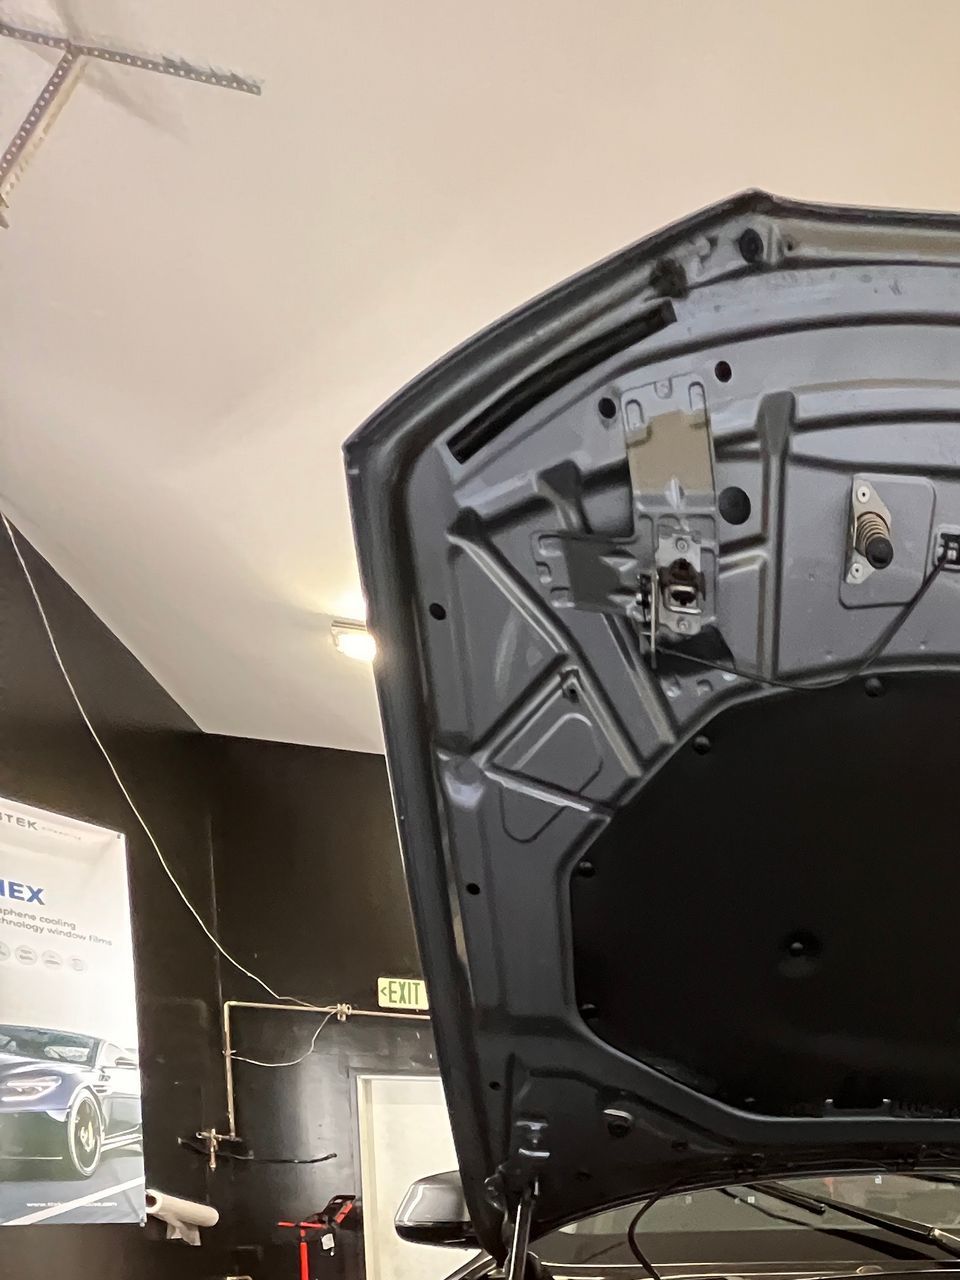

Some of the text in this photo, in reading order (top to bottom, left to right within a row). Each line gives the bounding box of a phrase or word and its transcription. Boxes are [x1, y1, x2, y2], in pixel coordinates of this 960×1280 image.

[0, 917, 112, 947] hnology window films
[39, 916, 76, 931] cooling
[389, 981, 421, 1005] EXIT
